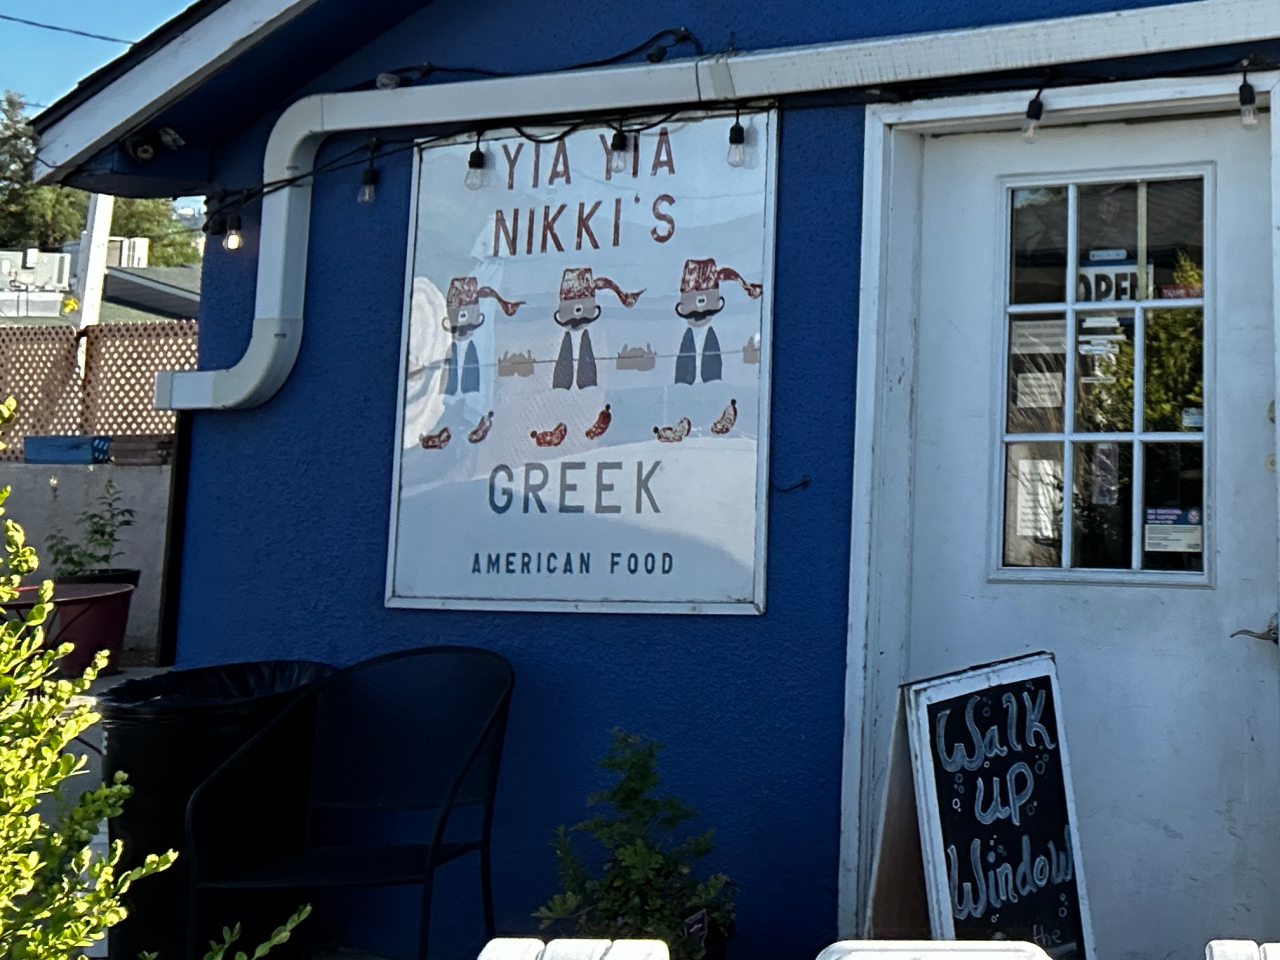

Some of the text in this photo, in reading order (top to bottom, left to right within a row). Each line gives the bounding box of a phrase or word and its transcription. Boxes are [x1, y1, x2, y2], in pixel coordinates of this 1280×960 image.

[502, 127, 676, 190] YIA YIA
[493, 193, 676, 257] NIKKI'S
[488, 461, 662, 515] GREEK
[471, 552, 674, 574] AMERICAN FOOD
